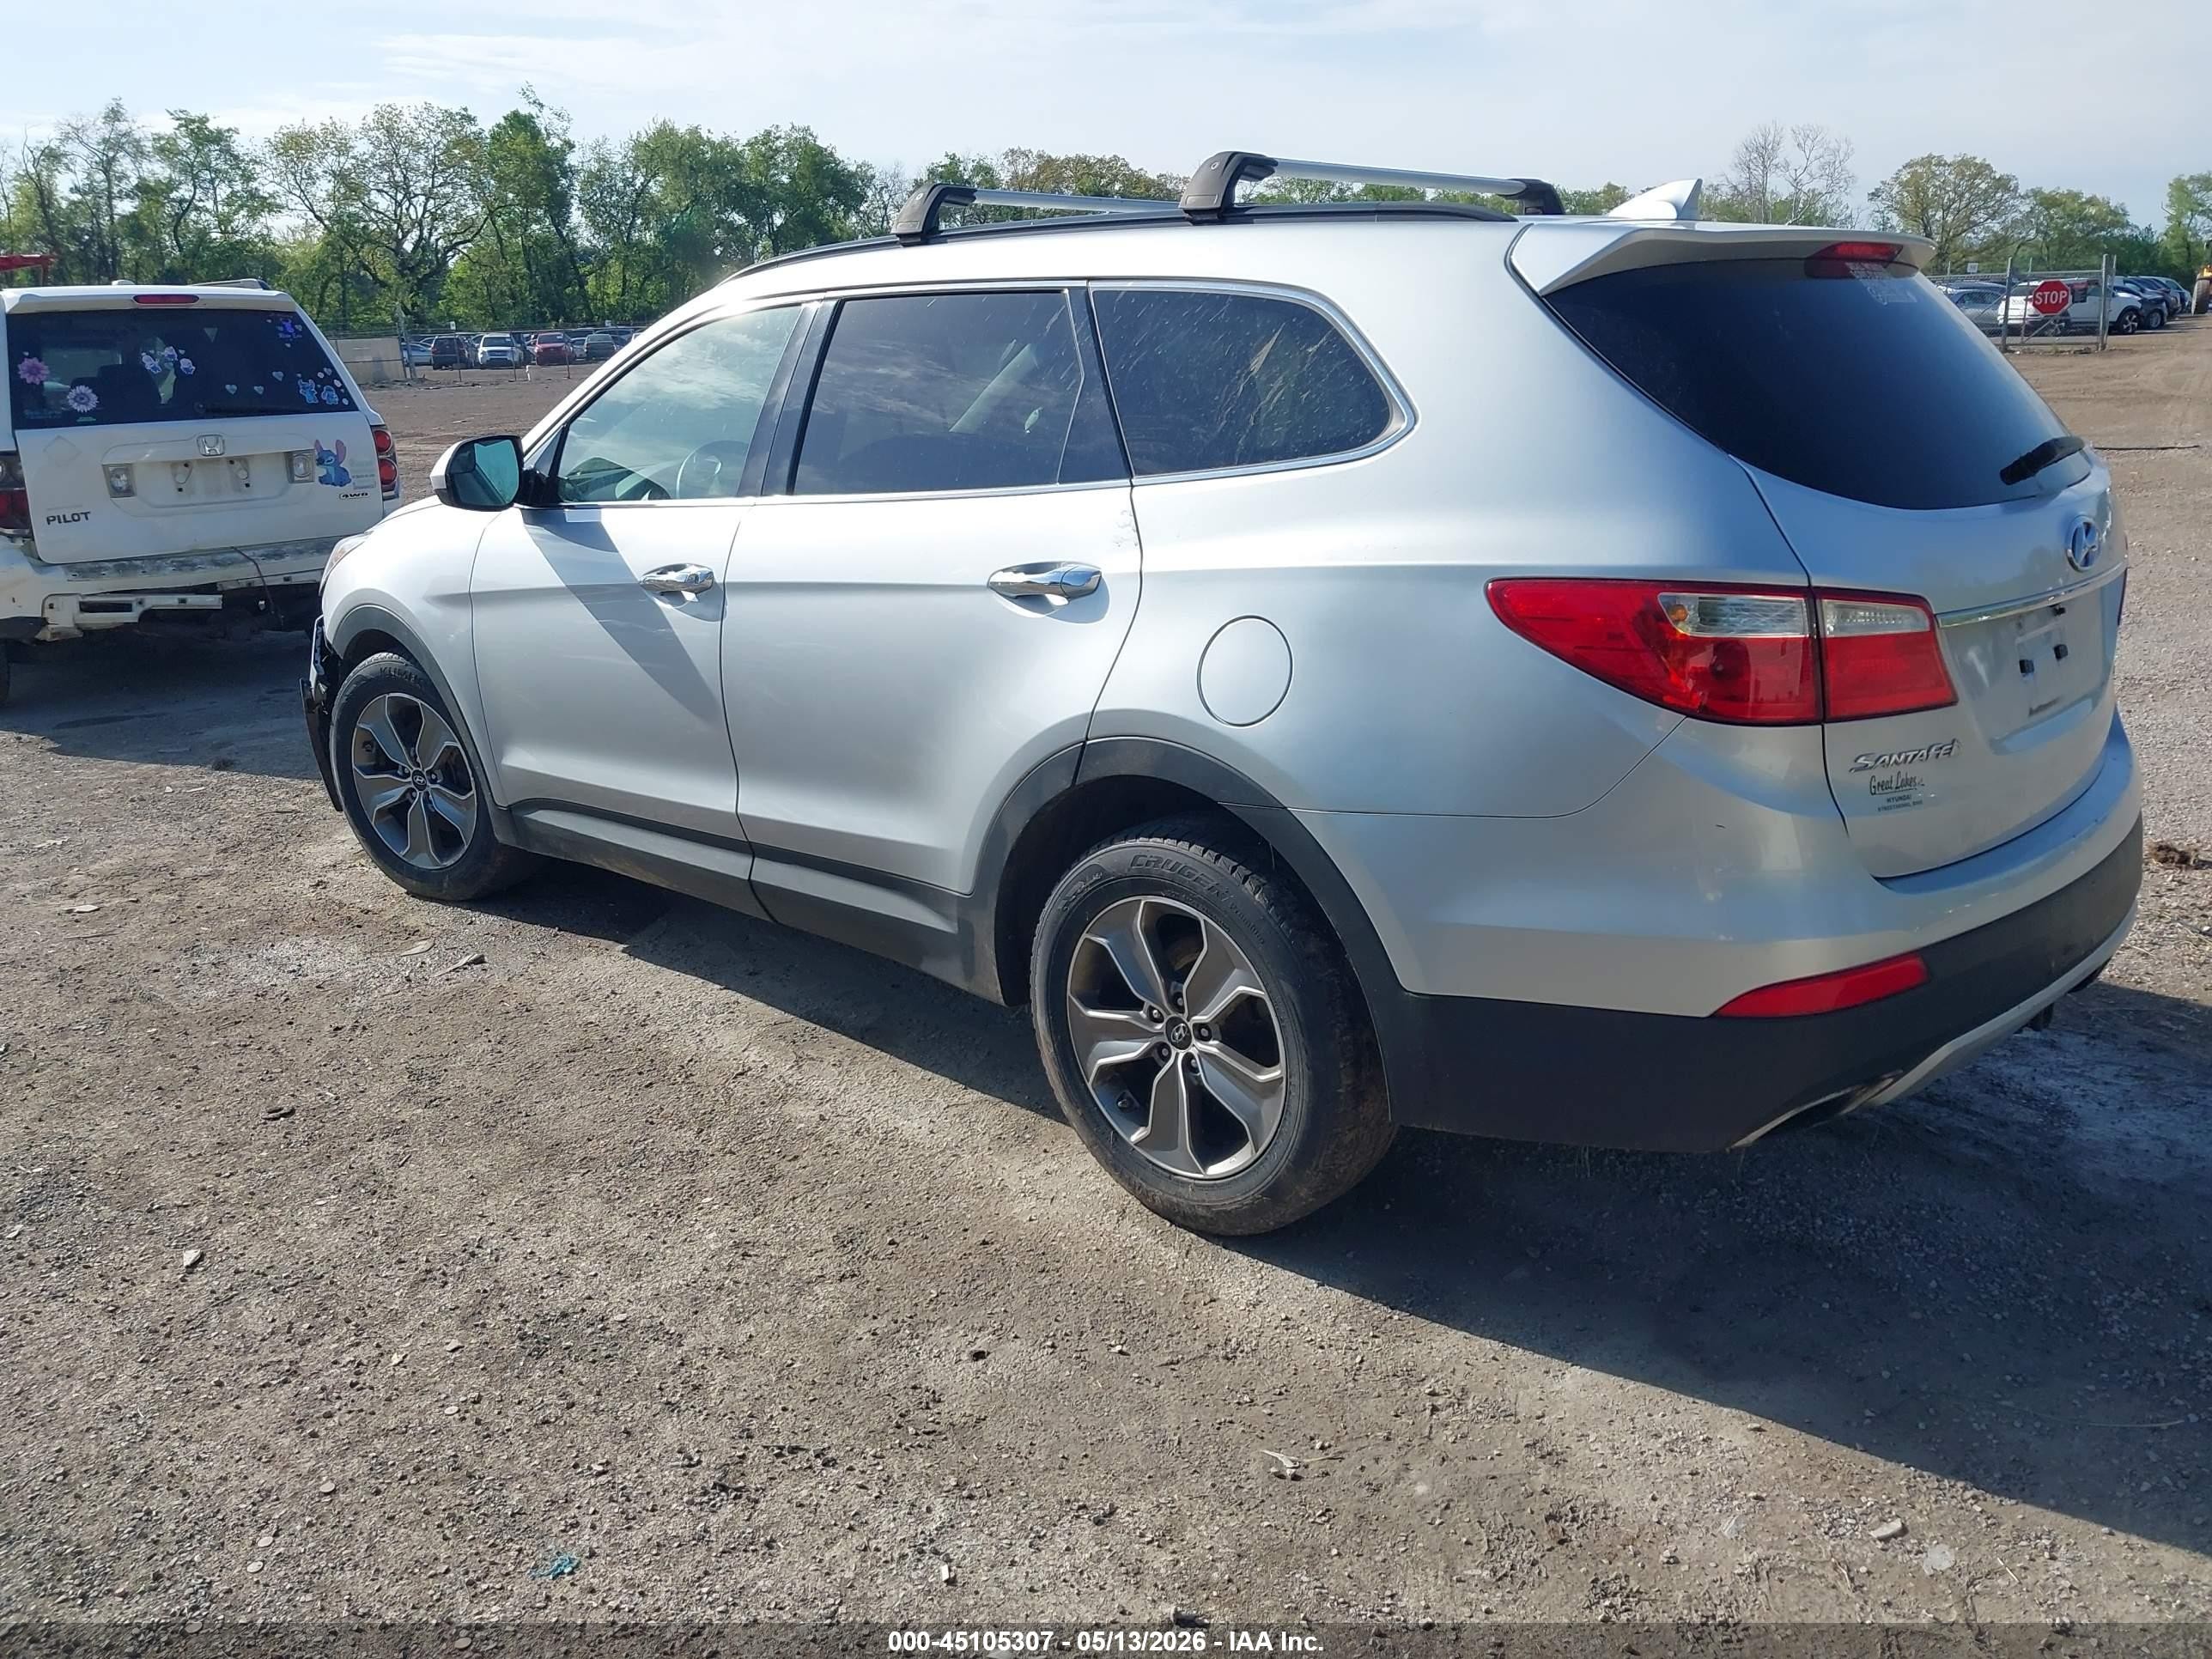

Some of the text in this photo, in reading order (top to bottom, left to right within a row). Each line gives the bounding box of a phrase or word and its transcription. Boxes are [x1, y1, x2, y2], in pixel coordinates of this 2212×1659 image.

[2034, 290, 2069, 306] STOP
[46, 511, 91, 526] PILOT
[1869, 770, 1917, 795] Great Lakes
